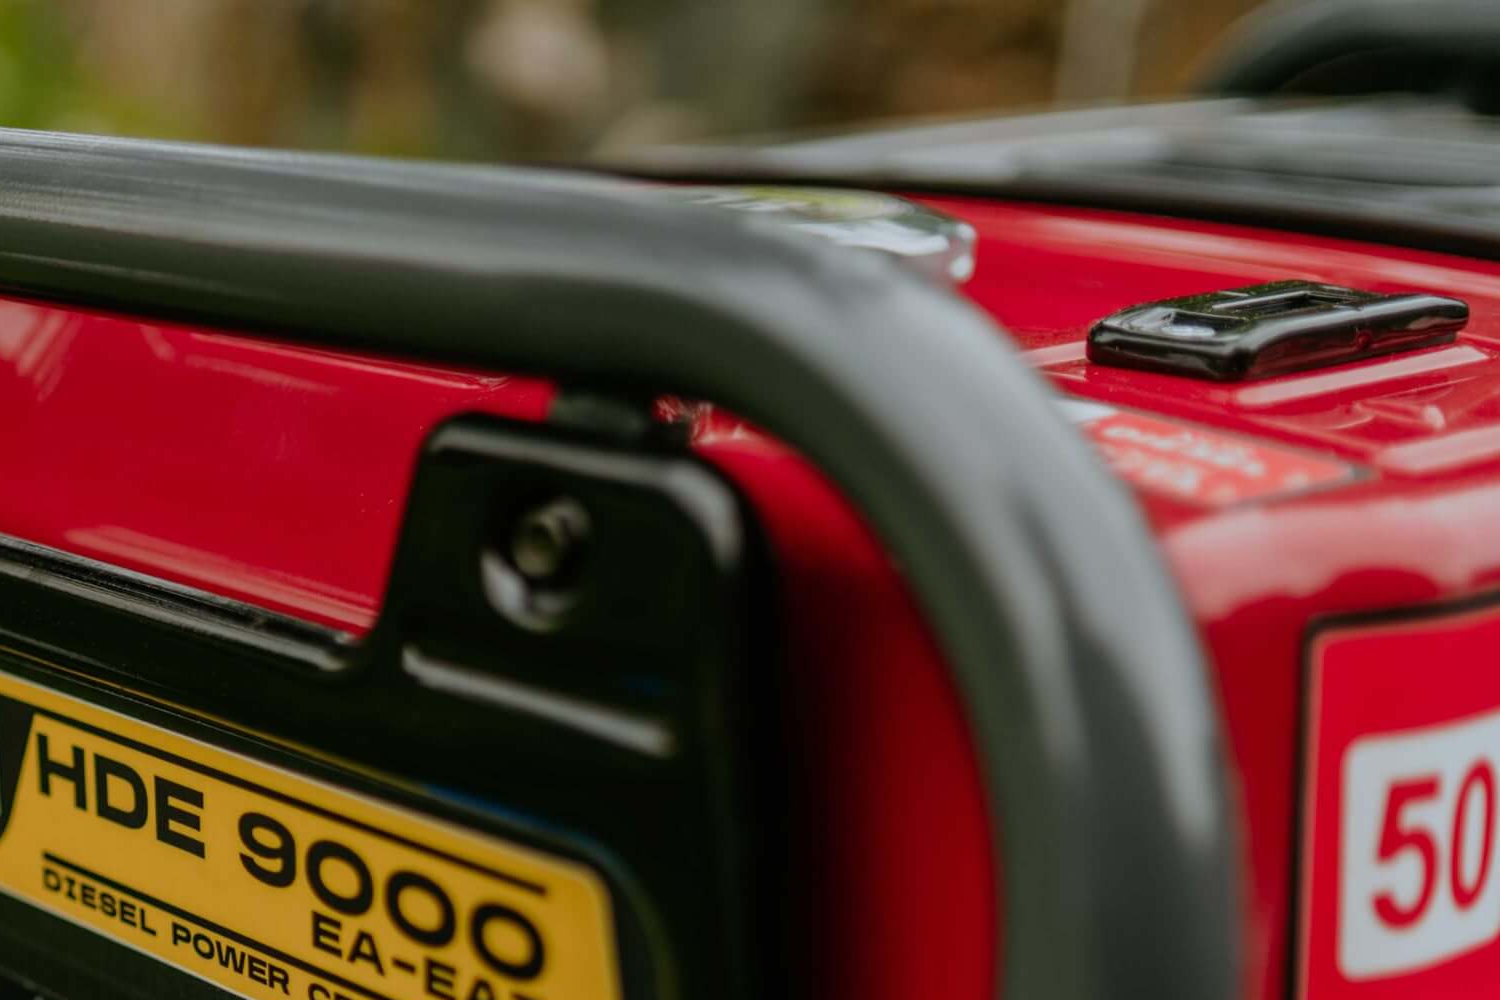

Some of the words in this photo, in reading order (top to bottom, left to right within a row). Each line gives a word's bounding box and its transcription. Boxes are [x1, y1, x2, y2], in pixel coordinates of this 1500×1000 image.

[37, 732, 206, 859] HDE
[238, 811, 546, 982] 9000
[41, 865, 156, 937] DIESEL
[172, 922, 291, 997] POWER
